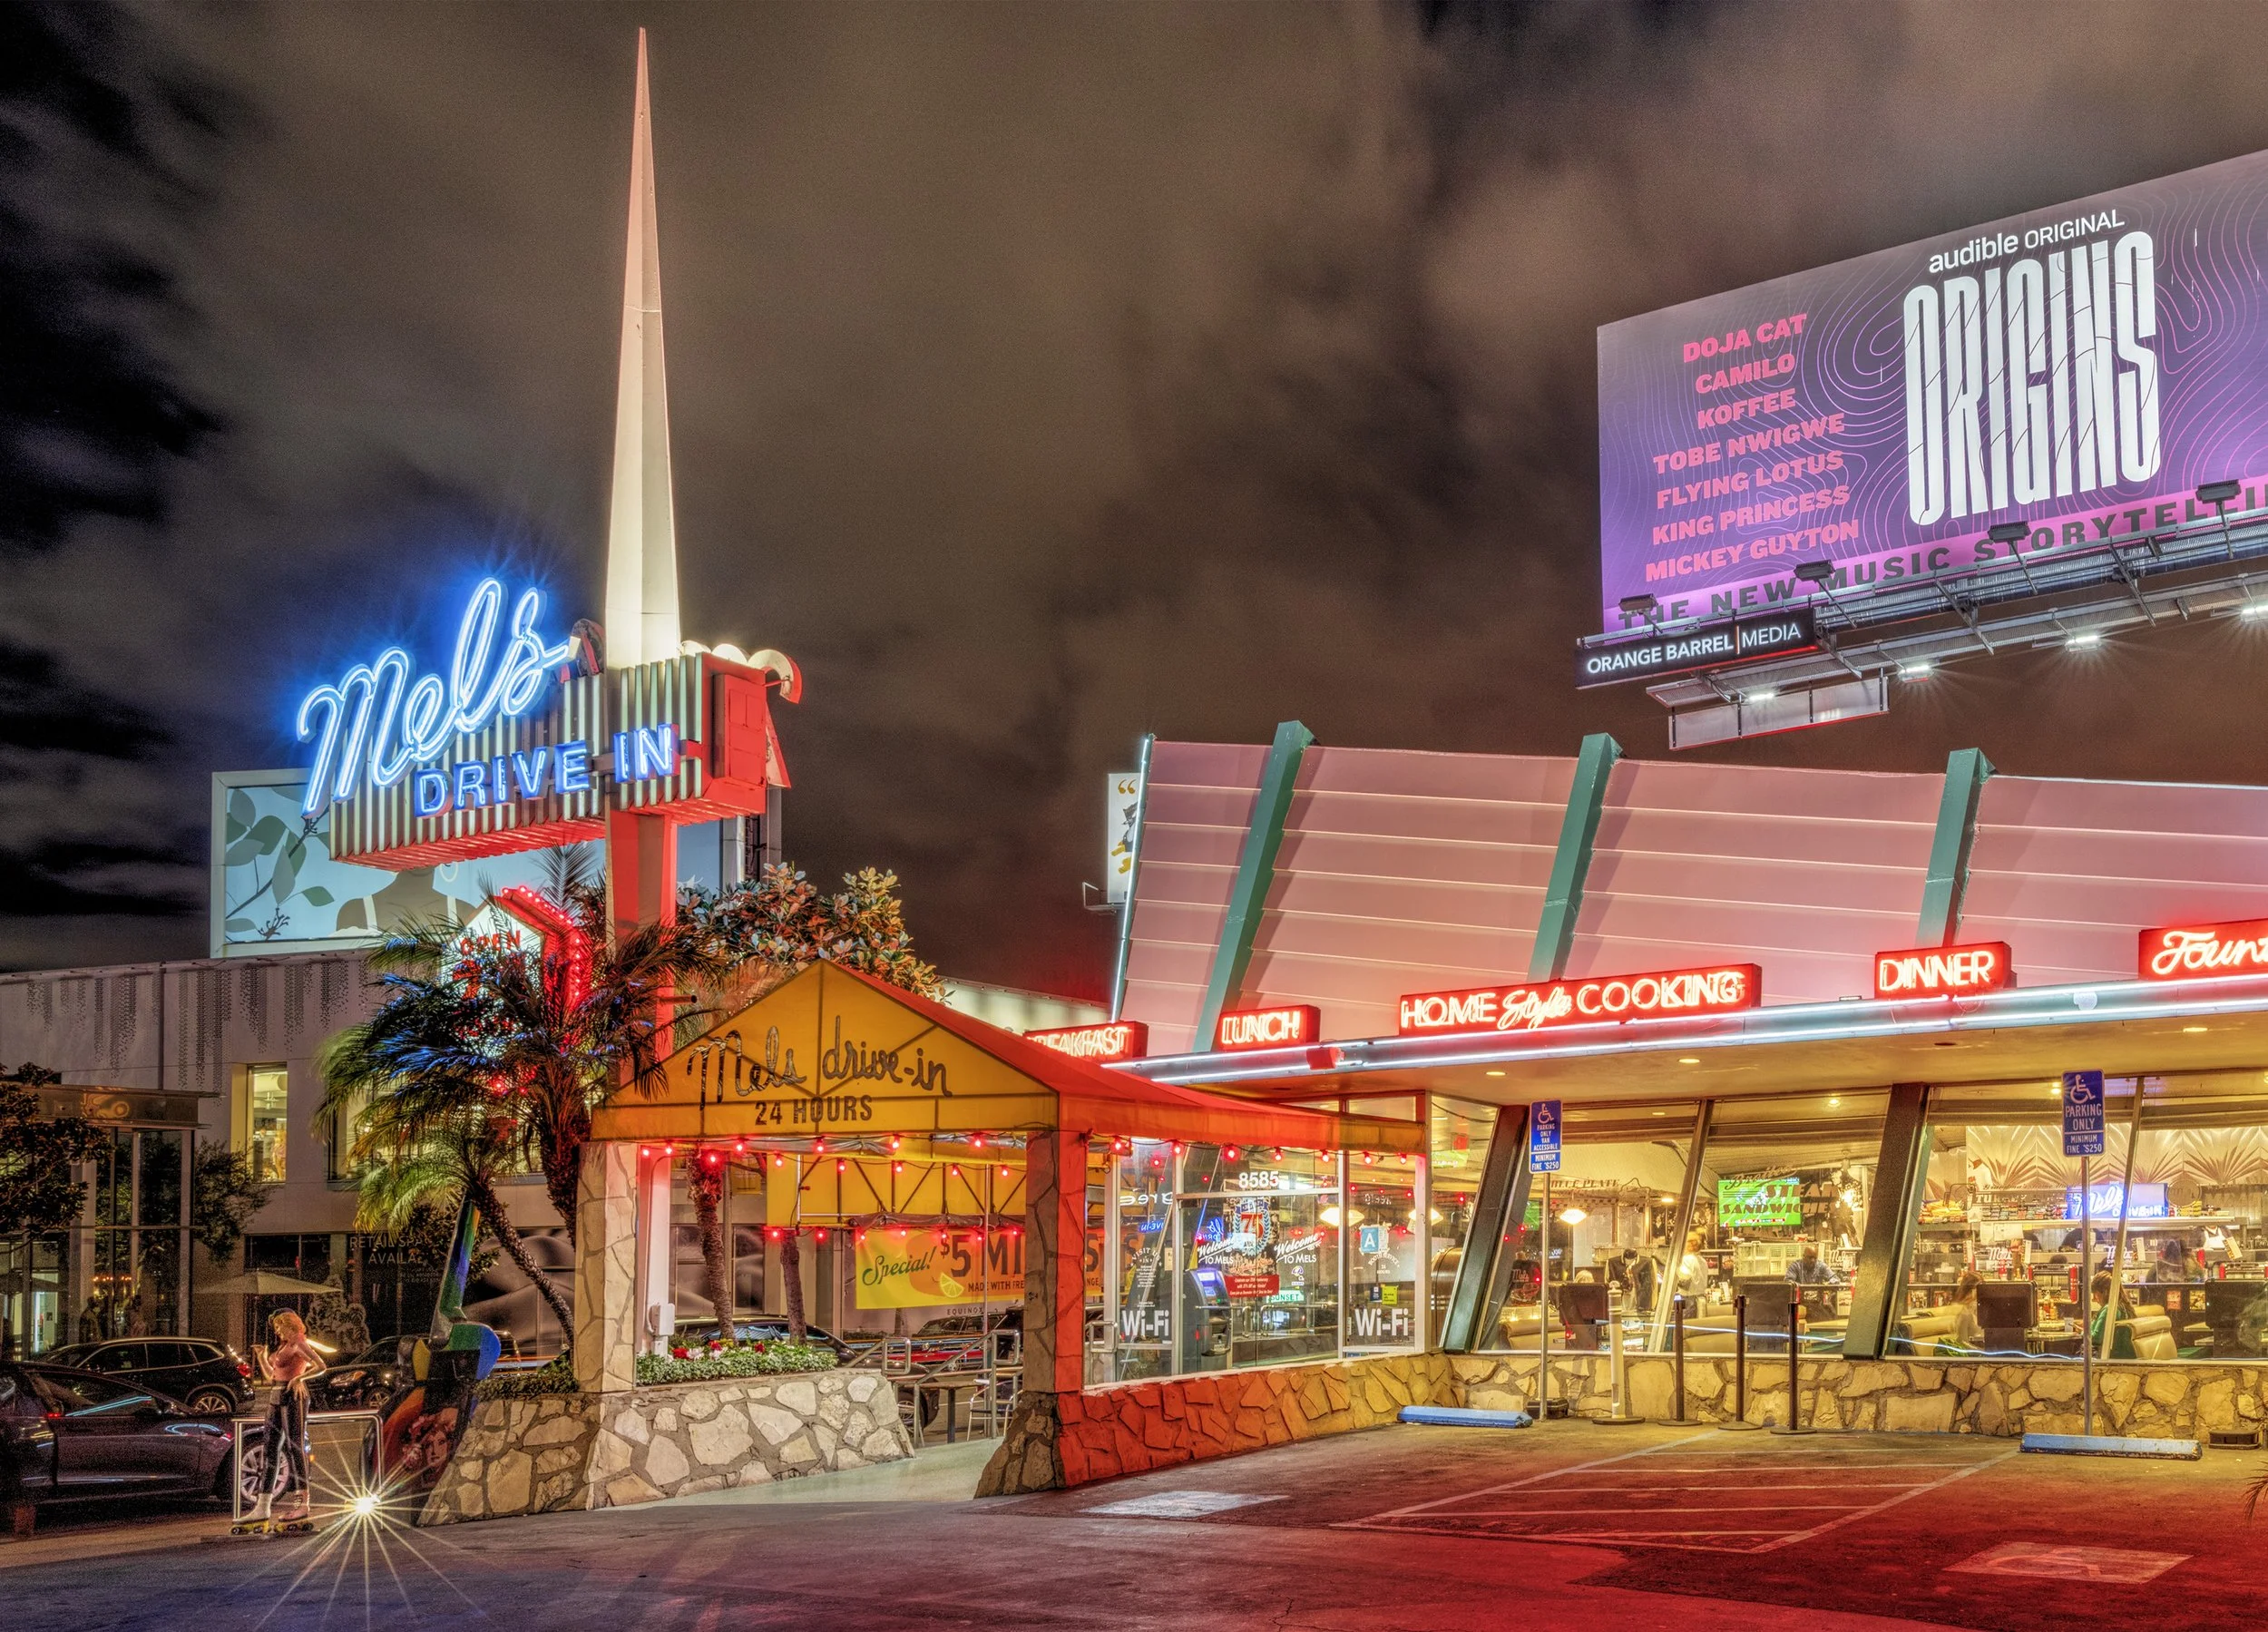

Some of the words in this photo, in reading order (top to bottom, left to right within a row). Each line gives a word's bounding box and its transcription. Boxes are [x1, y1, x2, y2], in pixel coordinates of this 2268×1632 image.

[1929, 232, 2019, 273] audible
[2024, 209, 2125, 249] ORIGINAL
[1683, 329, 1752, 363] DOJA
[1756, 313, 1807, 343] CAT
[1696, 353, 1796, 394] CAMILO
[1903, 231, 2161, 526] ORIGINS
[1697, 388, 1797, 430] KOFFEE
[1653, 442, 1721, 474] TOBE
[1727, 413, 1845, 457] NWIGWE
[1657, 472, 1749, 509] FLYING
[1755, 450, 1844, 487] LOTUS
[1652, 515, 1714, 545] KING
[1720, 485, 1851, 530] PRINCESS
[1646, 545, 1744, 581] MICKEY
[1750, 519, 1859, 560] GUYTON
[1712, 578, 1797, 612] NEW
[1819, 548, 1950, 592] MUSIC
[1588, 646, 1662, 674] ORANGE
[1666, 637, 1734, 664] BARREL
[1742, 623, 1801, 648] MEDIA
[297, 577, 571, 816] Mels
[414, 740, 591, 816] DRIVE
[613, 723, 680, 783] IN
[1879, 951, 1995, 992] DINNER
[1401, 992, 1498, 1029] HOME
[1497, 986, 1571, 1031] Style
[1576, 971, 1745, 1014] COOKING
[1027, 1026, 1132, 1058] EAKFAST
[1221, 1010, 1301, 1045] LUNCH
[687, 1026, 807, 1110] Mels
[822, 1015, 953, 1098] drive-in
[755, 1101, 783, 1126] 24
[793, 1095, 873, 1124] HOURS
[2065, 1104, 2102, 1118] PARKING
[2072, 1118, 2096, 1130] ONLY
[1533, 1143, 1558, 1151] ACCESSIBLE
[2067, 1145, 2080, 1154] FINE
[2070, 1134, 2097, 1143] MINIMUM
[1238, 1171, 1279, 1188] 8585
[1583, 1178, 1620, 1187] PLATE
[1240, 1212, 1264, 1238] 75
[1364, 1233, 1375, 1247] A
[349, 1236, 395, 1248] RETAIL
[1132, 1247, 1150, 1260] VISIT
[1198, 1236, 1236, 1257] Welcome
[1274, 1232, 1322, 1257] Welcome
[368, 1252, 424, 1264] AVAILA
[862, 1246, 937, 1286] Special!
[940, 1235, 972, 1277] $5
[1204, 1256, 1215, 1265] TO
[1215, 1255, 1234, 1265] MELS
[1283, 1256, 1294, 1264] TO
[1295, 1254, 1316, 1264] MELS
[991, 1281, 1011, 1290] WITH
[1122, 1310, 1169, 1336] Wi-Fi
[1354, 1308, 1409, 1336] Wi-Fi
